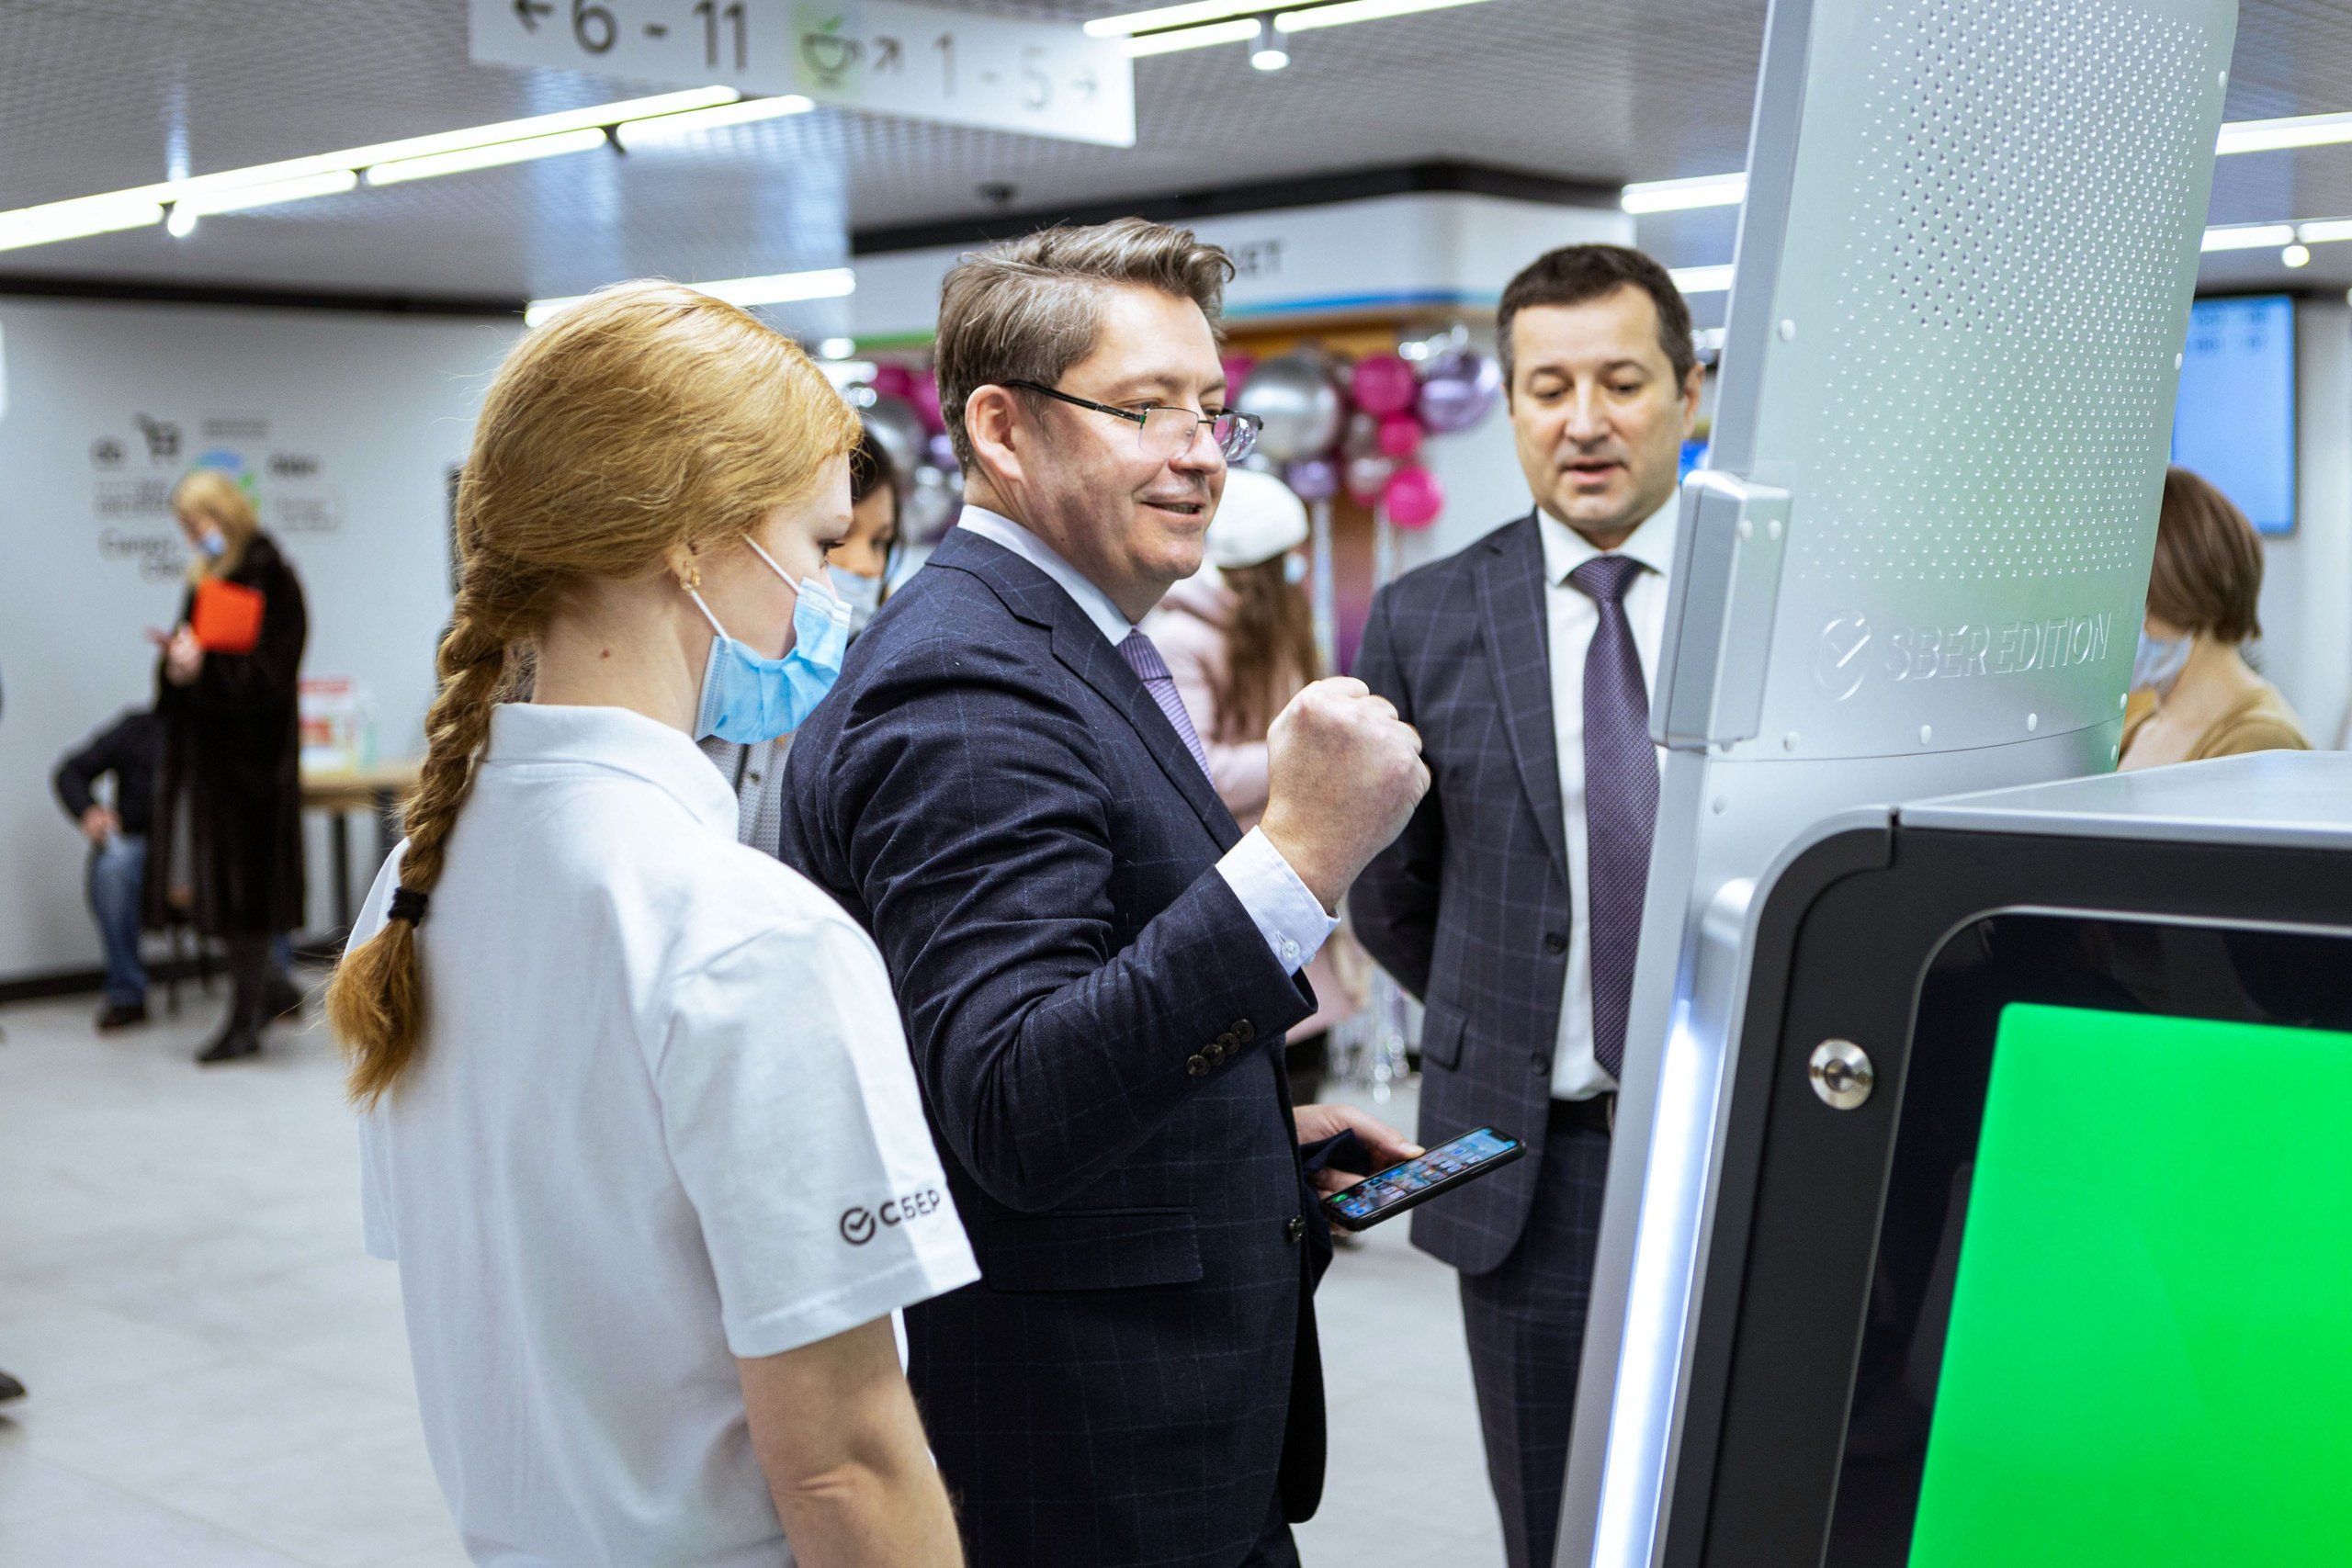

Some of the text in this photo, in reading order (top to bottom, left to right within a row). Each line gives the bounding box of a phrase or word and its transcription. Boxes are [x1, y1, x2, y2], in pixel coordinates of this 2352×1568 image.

[571, 0, 617, 55] 6
[693, 0, 747, 70] 11
[931, 33, 956, 98] 1
[1019, 46, 1052, 110] 5
[1886, 611, 2112, 681] SBER EDITION
[879, 1190, 940, 1226] СБЕР
